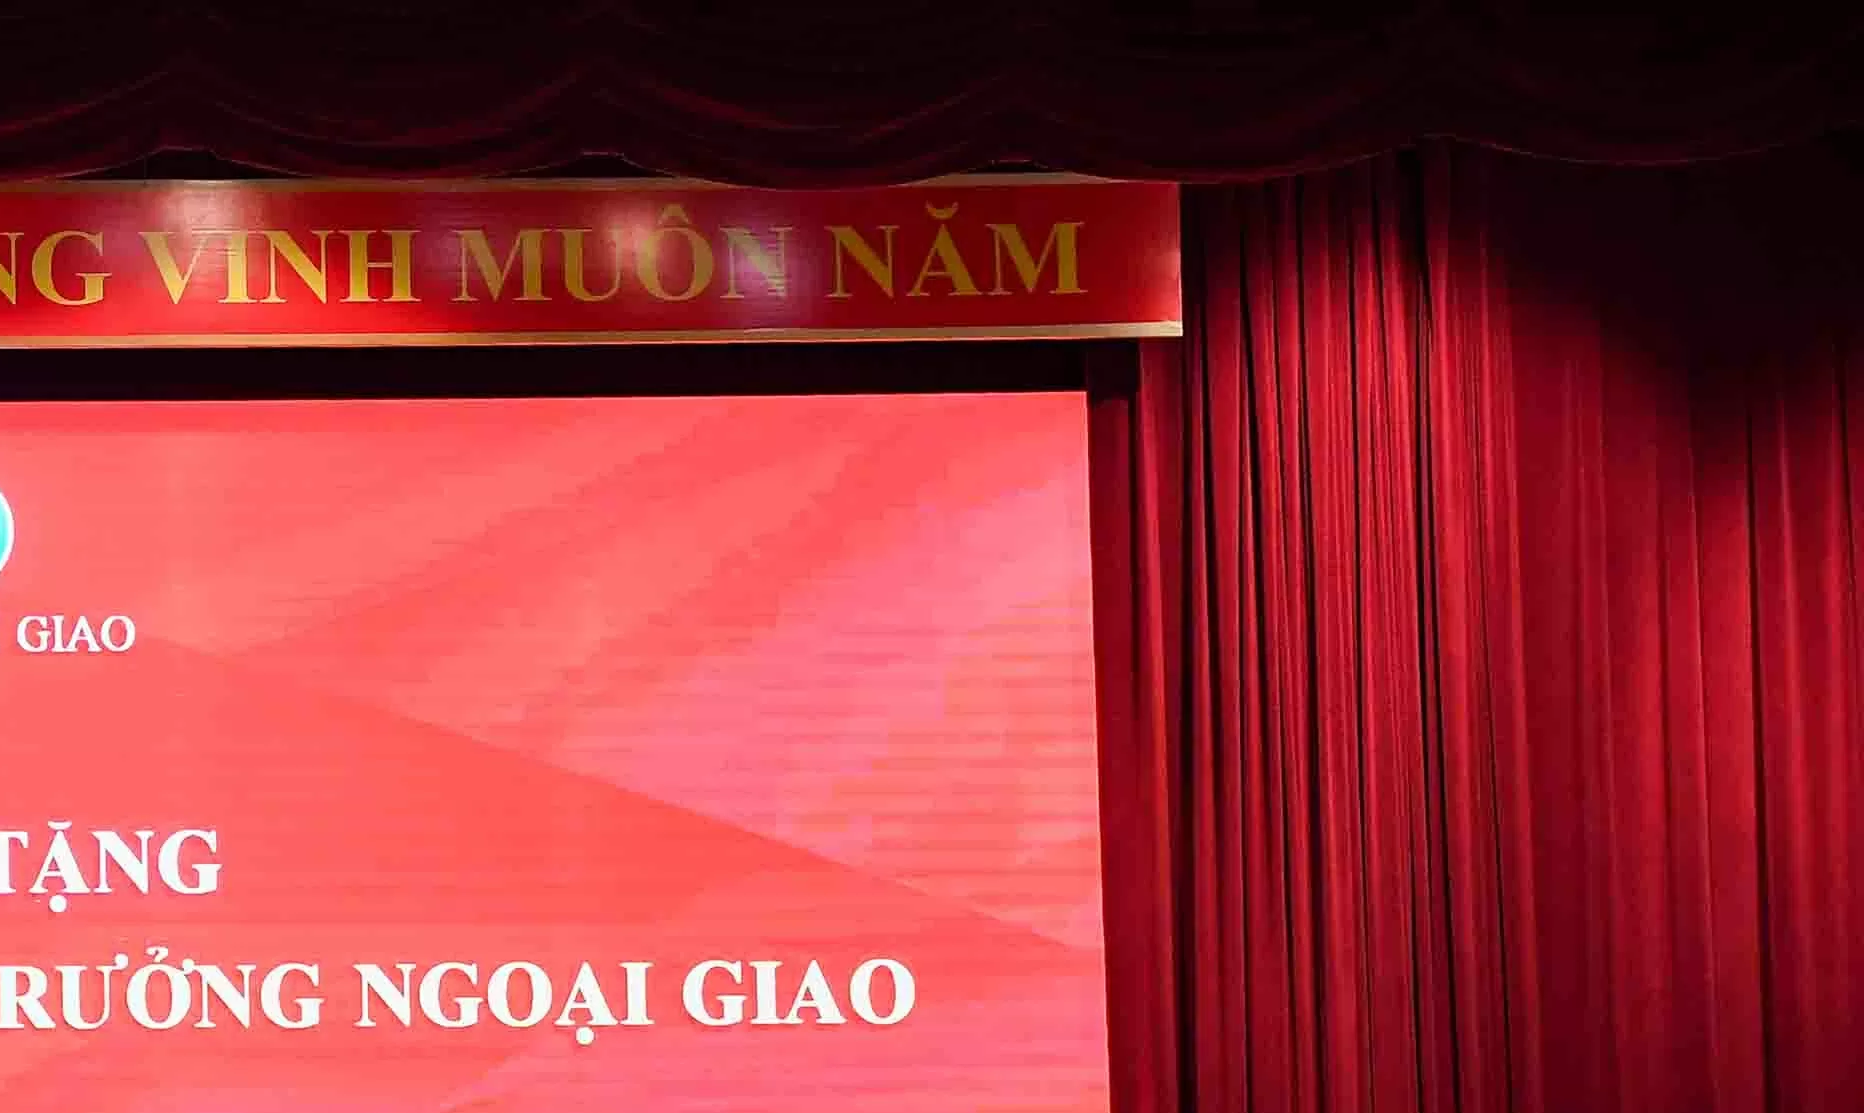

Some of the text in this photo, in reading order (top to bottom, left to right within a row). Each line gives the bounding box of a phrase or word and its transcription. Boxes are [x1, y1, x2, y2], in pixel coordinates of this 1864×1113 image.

[137, 228, 422, 306] VINH
[456, 204, 790, 303] MUÔN
[827, 202, 1091, 299] NĂM
[17, 615, 136, 653] GIAO
[353, 961, 654, 1045] NGOẠI
[682, 958, 916, 1026] GIAO
